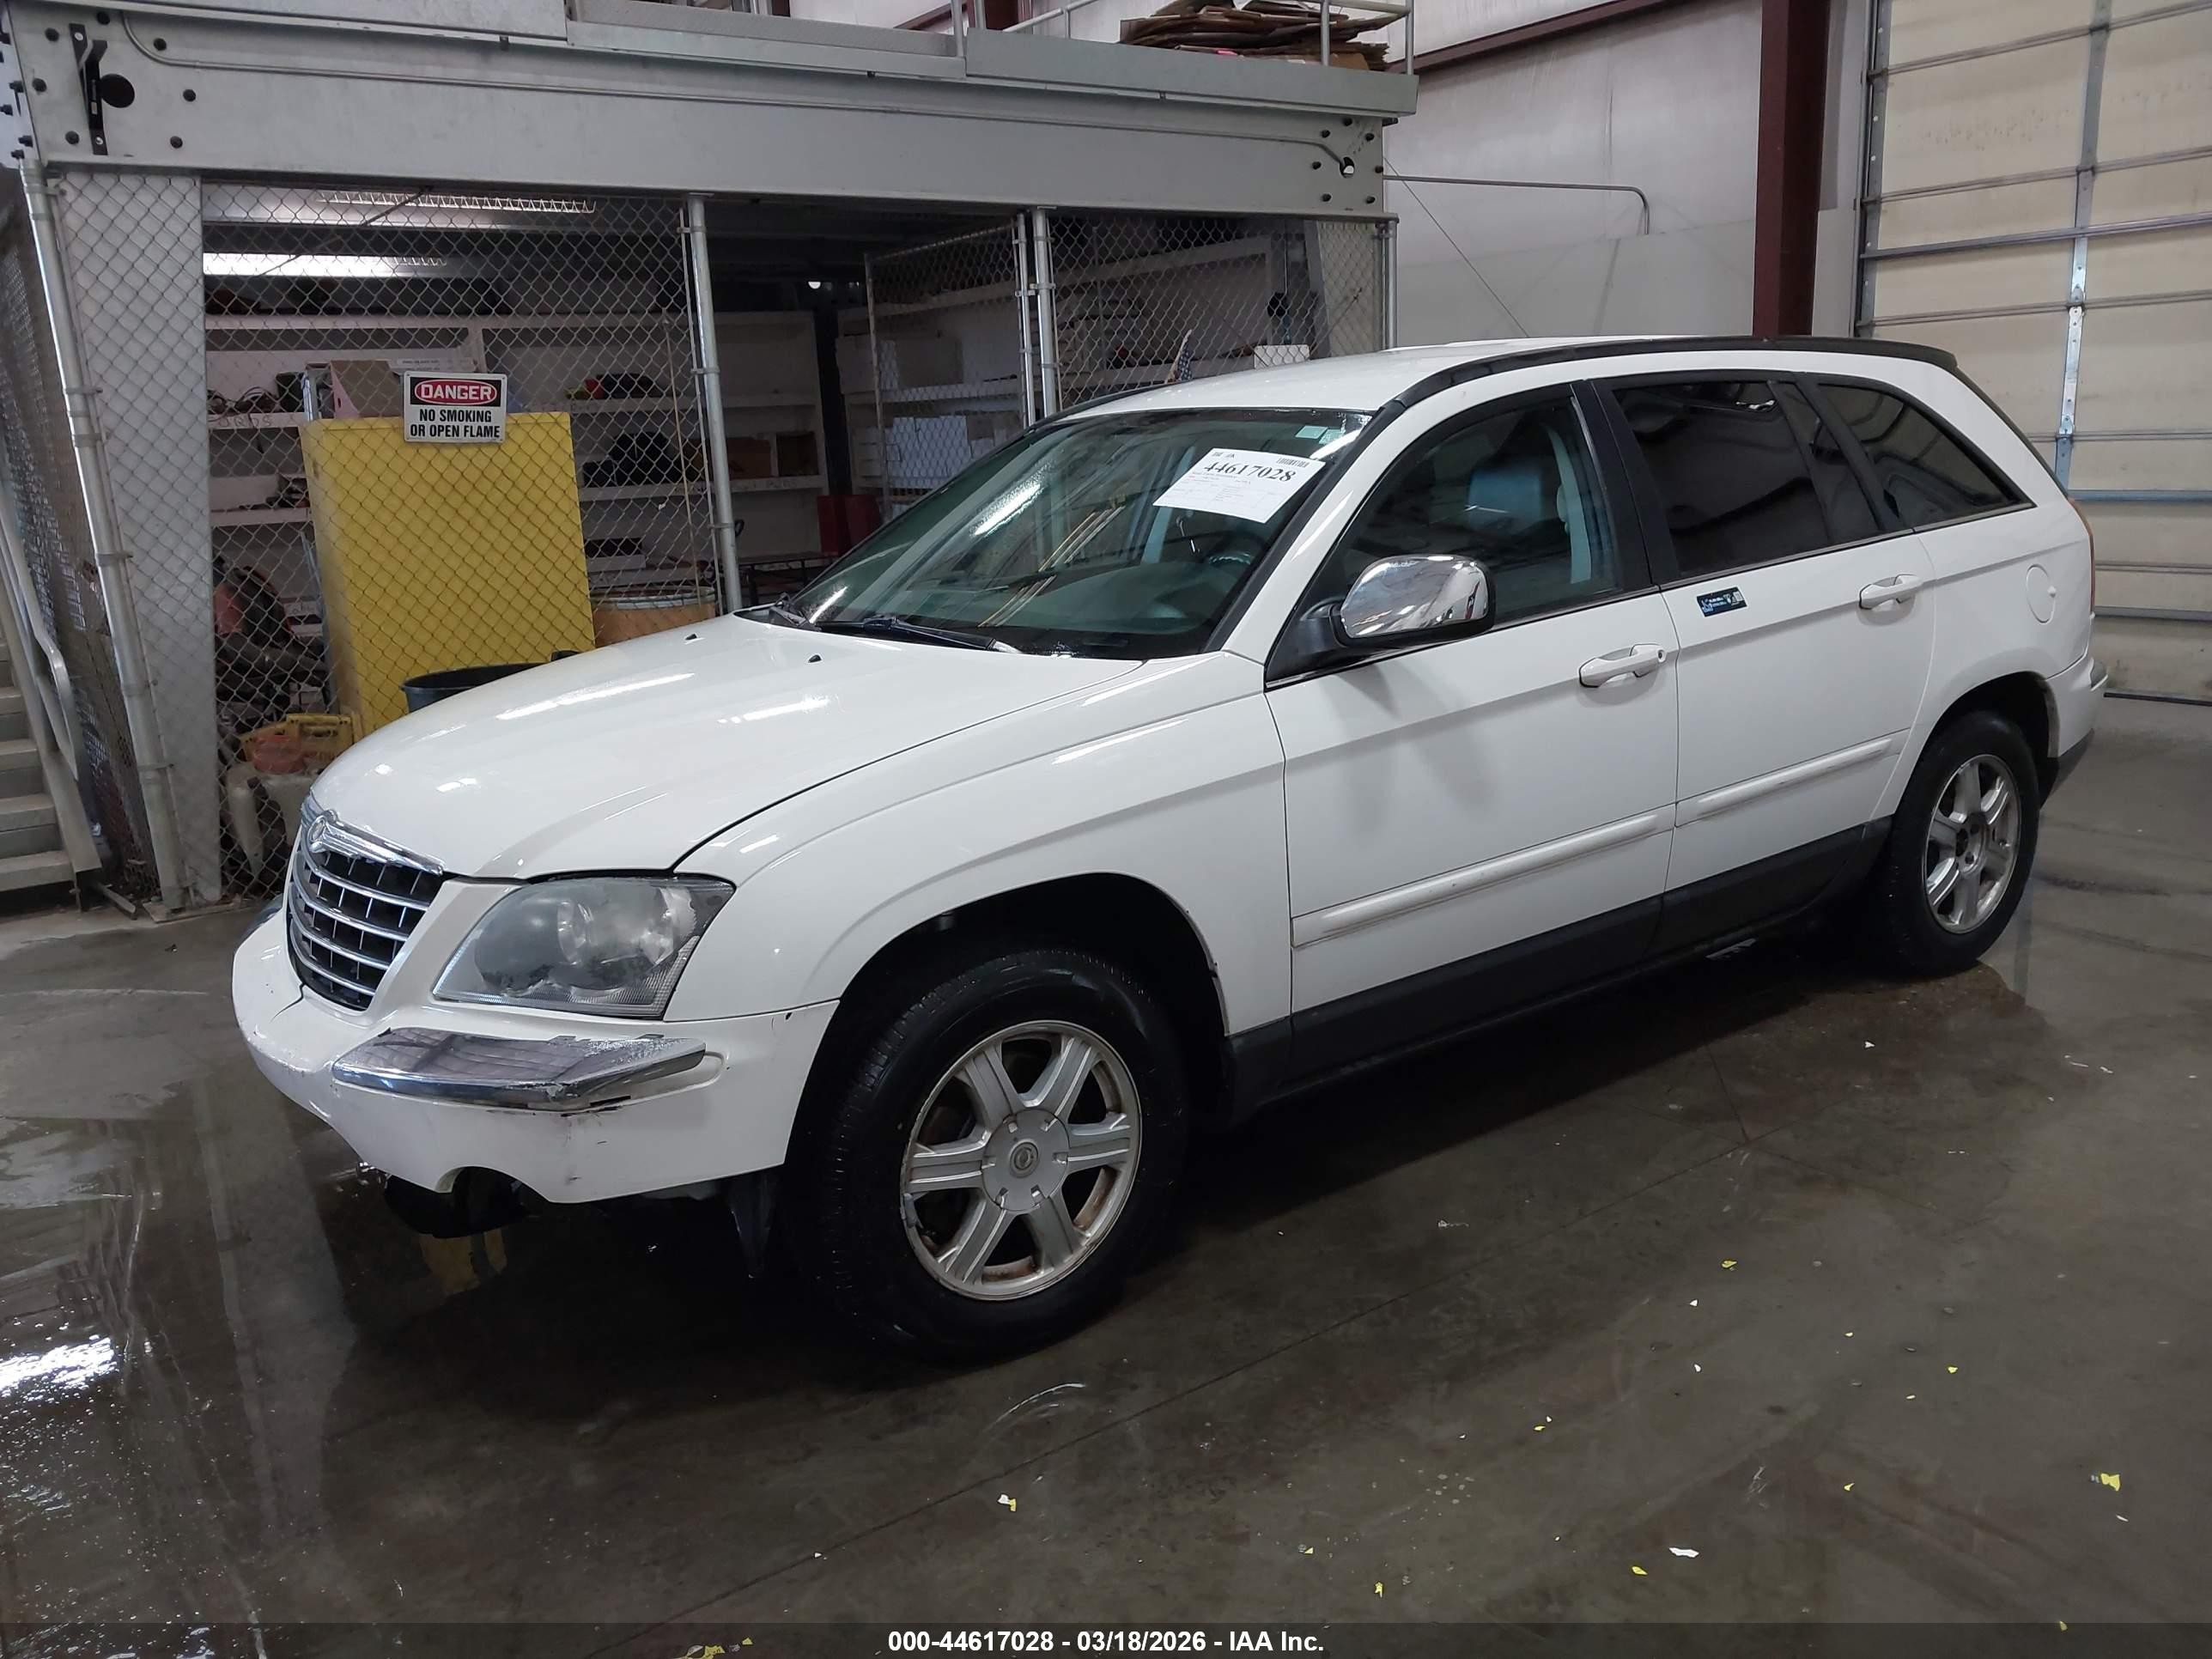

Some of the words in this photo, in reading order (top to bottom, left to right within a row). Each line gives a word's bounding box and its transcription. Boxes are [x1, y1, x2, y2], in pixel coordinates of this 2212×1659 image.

[421, 384, 492, 400] DANGER
[419, 409, 435, 422] NO
[440, 409, 492, 422] SMOKING
[410, 424, 426, 437] OR
[429, 424, 459, 437] OPEN
[464, 425, 501, 438] FLAME
[1204, 462, 1296, 482] 44617028
